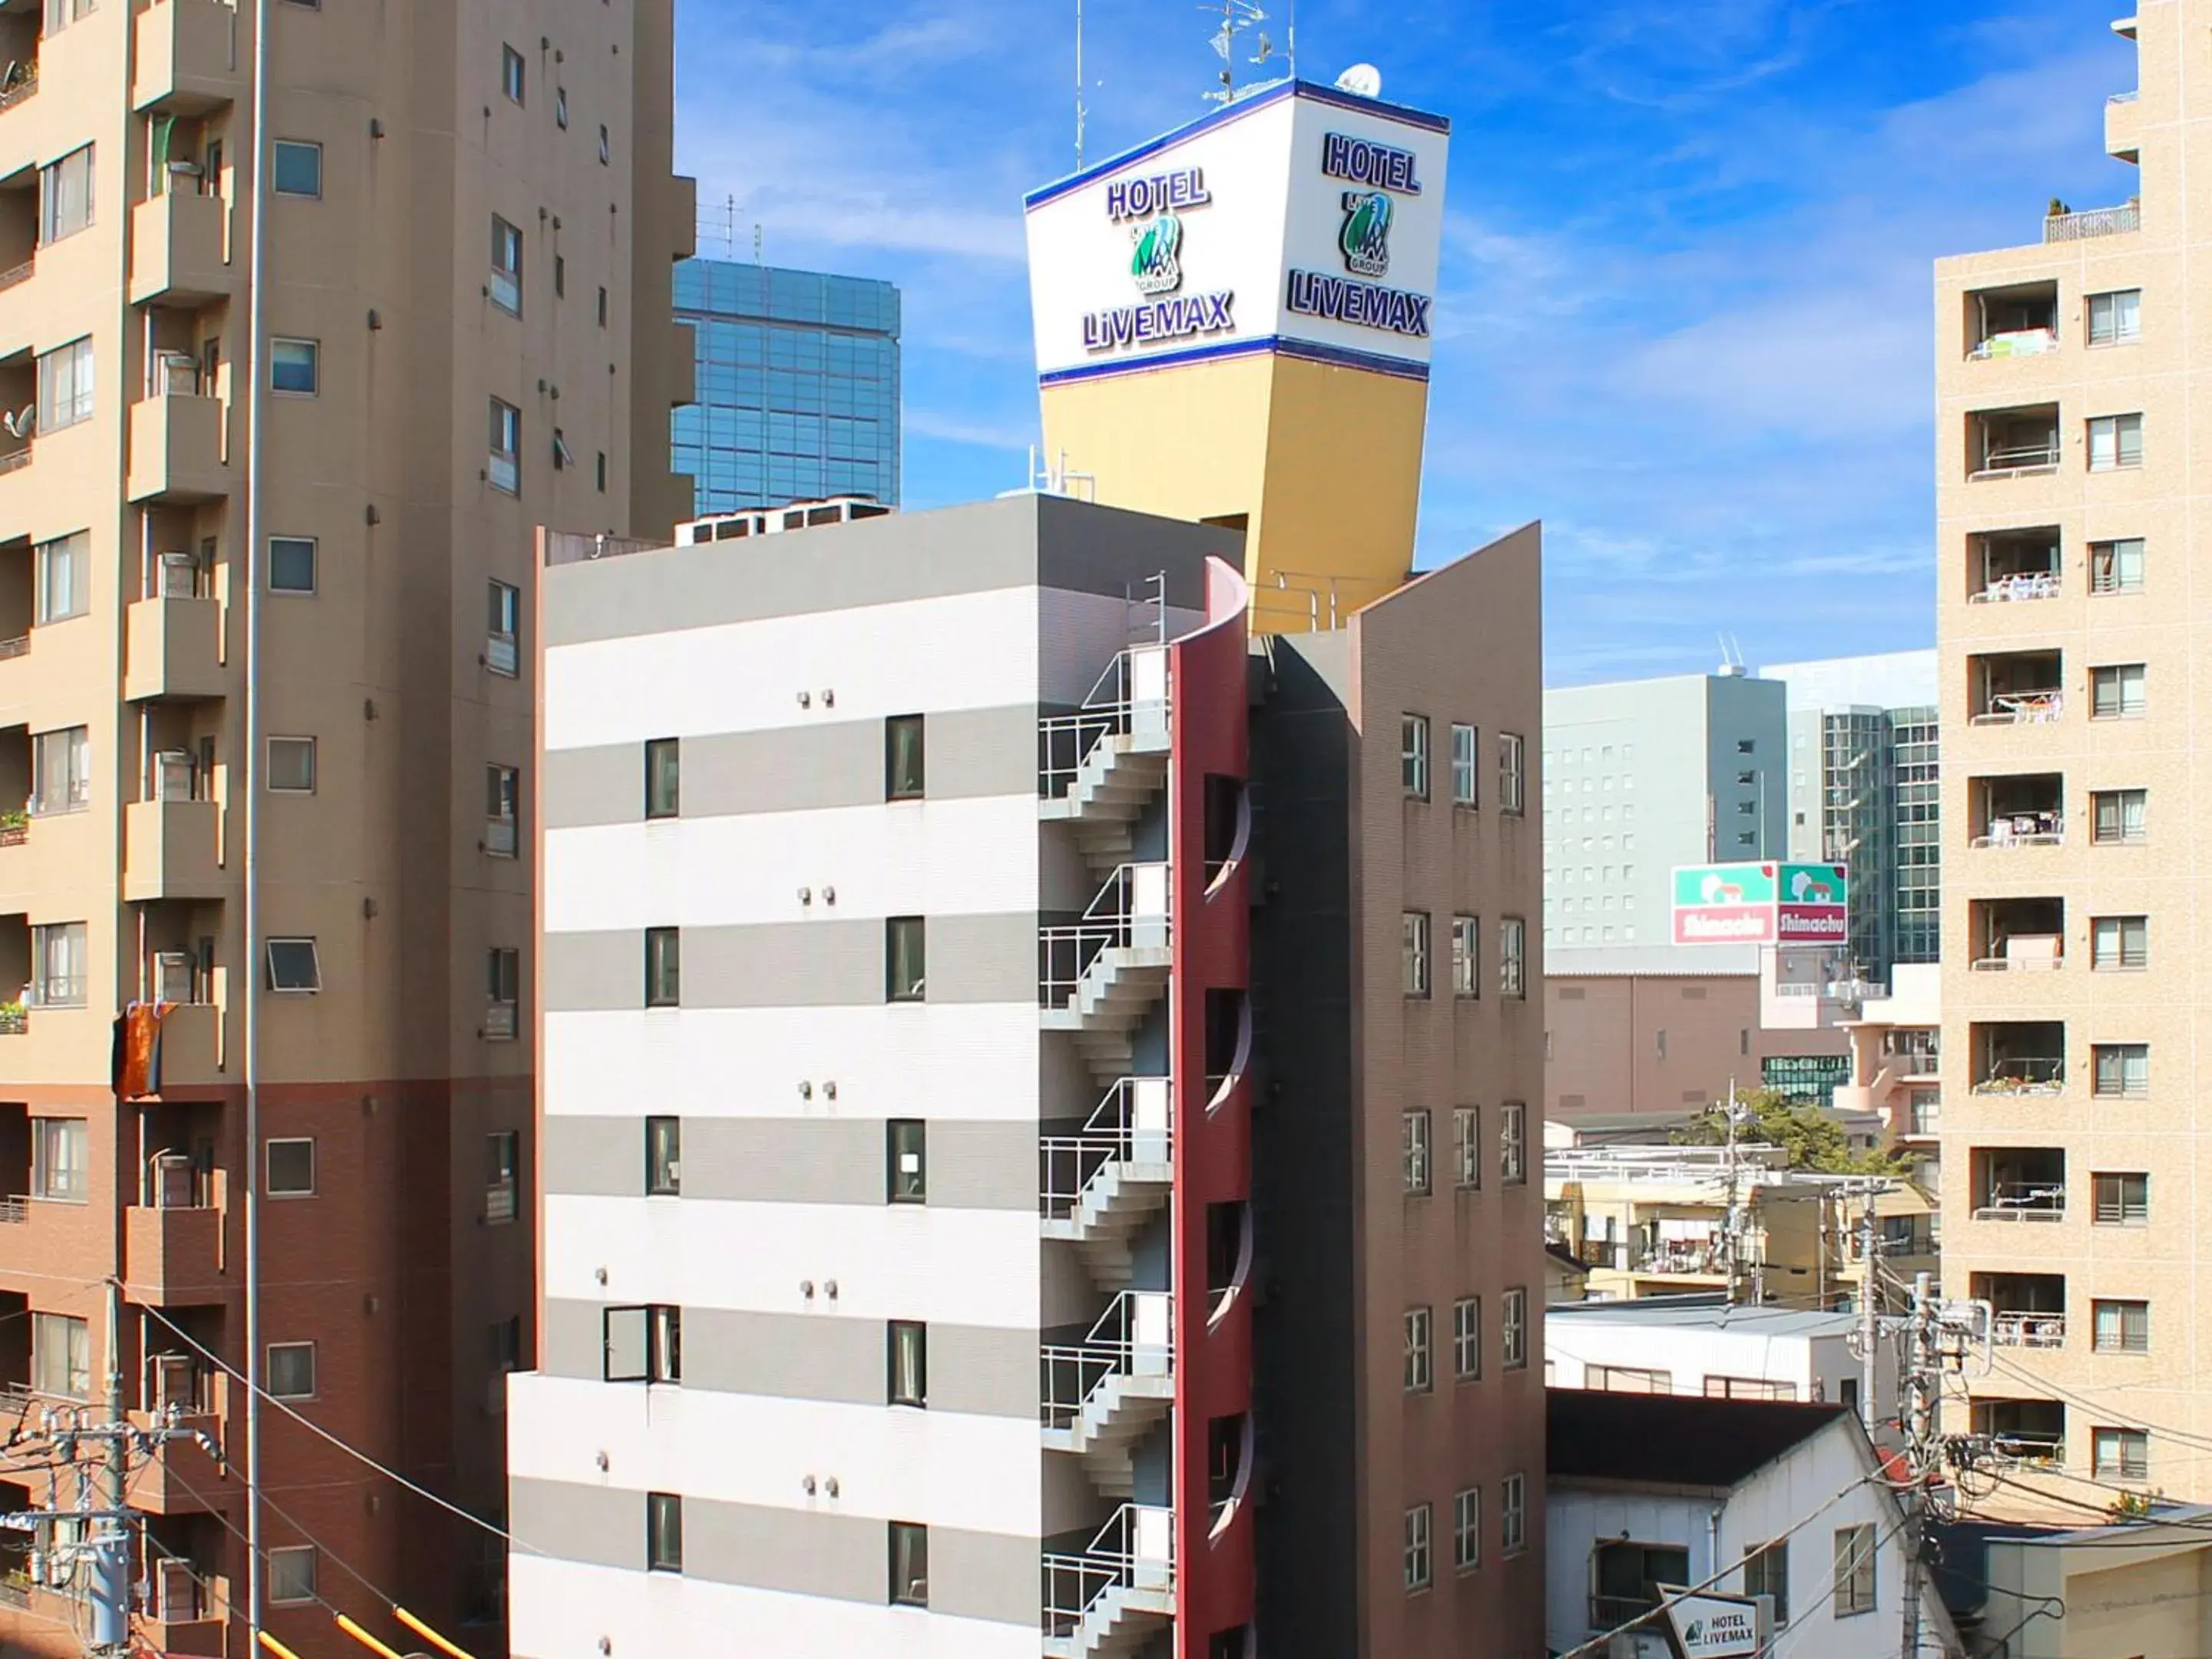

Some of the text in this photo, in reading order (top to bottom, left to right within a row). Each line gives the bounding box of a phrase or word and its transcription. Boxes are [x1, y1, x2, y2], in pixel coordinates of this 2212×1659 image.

[1323, 133, 1421, 194] HOTEL
[1107, 168, 1210, 218] HOTEL
[1351, 258, 1386, 273] GROUP
[1780, 913, 1843, 932] Shimachu
[1711, 1614, 1746, 1628] HOTEL
